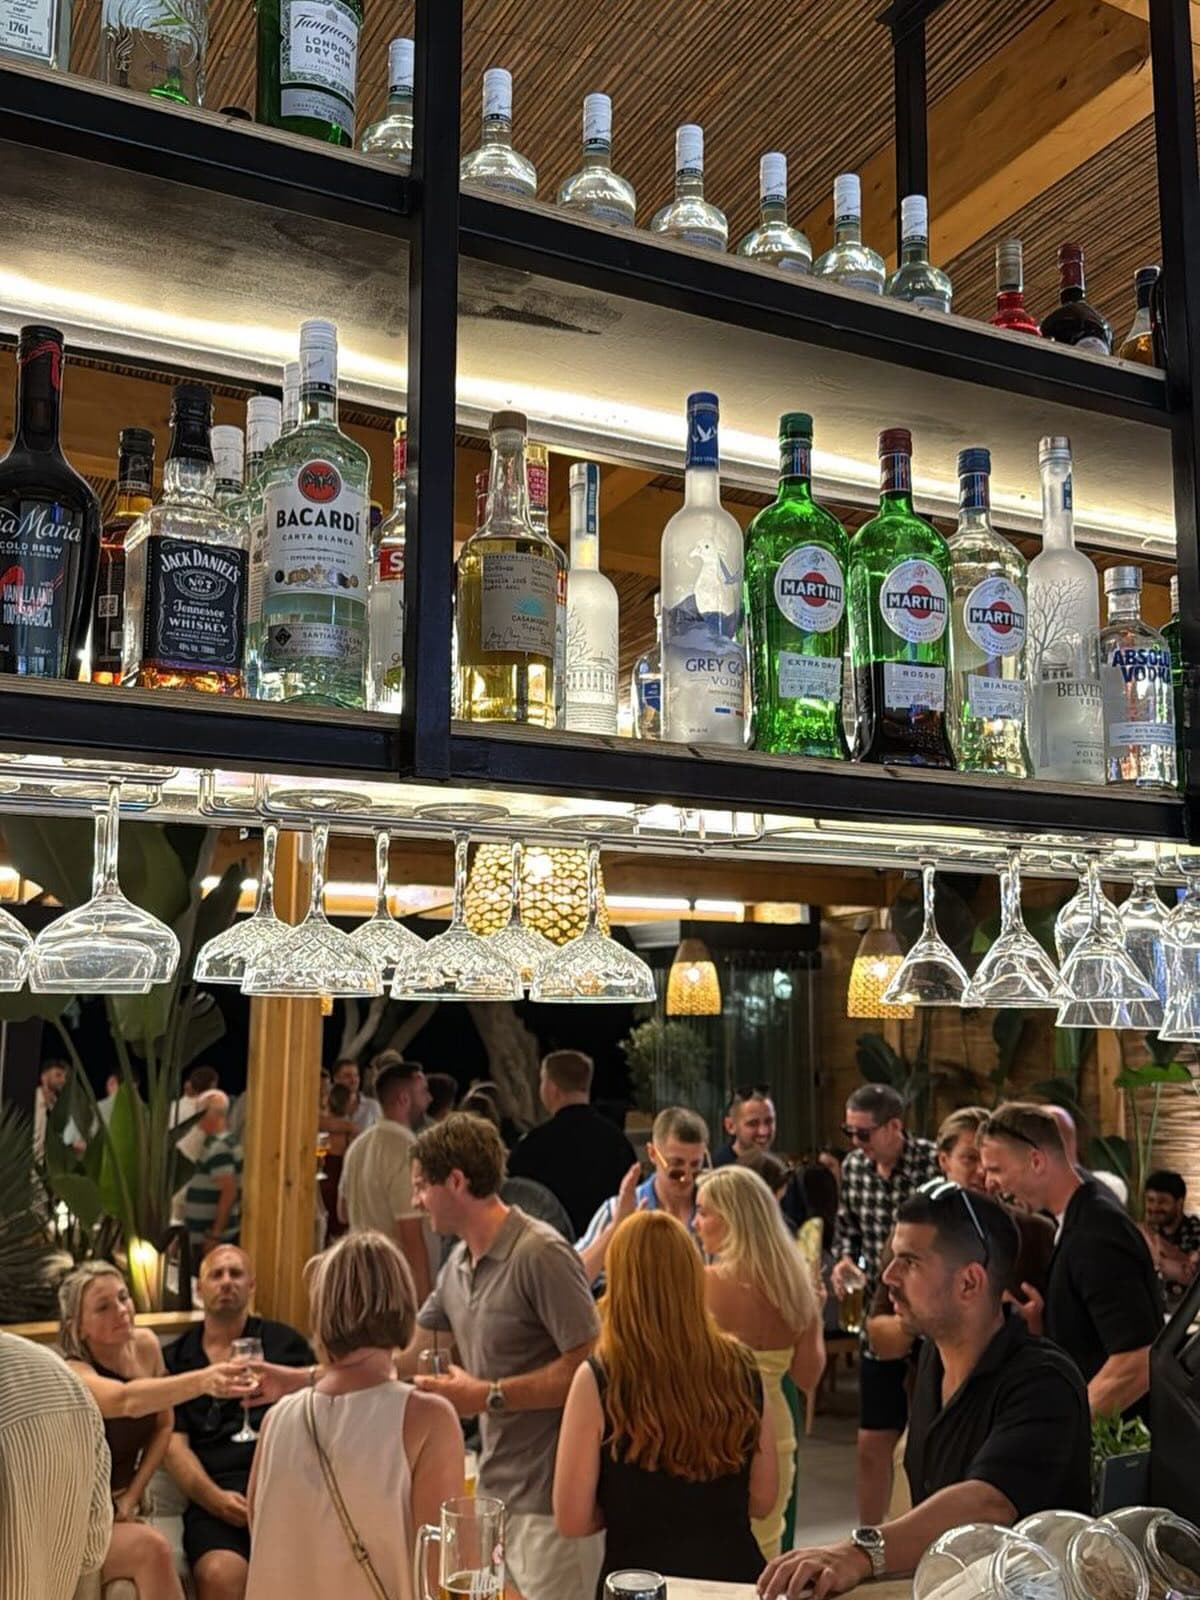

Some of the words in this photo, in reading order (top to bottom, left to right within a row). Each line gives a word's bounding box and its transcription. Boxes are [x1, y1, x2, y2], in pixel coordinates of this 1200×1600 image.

[9, 21, 28, 35] 1761
[305, 35, 351, 60] LONDON
[305, 45, 330, 57] DRY
[333, 53, 350, 69] GIN
[12, 504, 81, 542] Maria
[0, 541, 28, 551] COLD
[32, 543, 62, 554] BREW
[282, 533, 313, 541] CARTA
[317, 534, 354, 547] BLANCA
[160, 551, 191, 573] JACK
[193, 549, 241, 584] DANIEL'S
[783, 580, 840, 602] MARTINI
[889, 595, 944, 613] MARTINI
[169, 616, 228, 634] WHISKEY
[971, 609, 1024, 629] MARTINI
[686, 658, 724, 672] GREY
[1112, 649, 1170, 668] ABSOLU
[711, 675, 744, 688] VOD
[902, 670, 936, 680] ROSSO
[1121, 665, 1171, 683] VODK
[983, 680, 1019, 692] BIANCO
